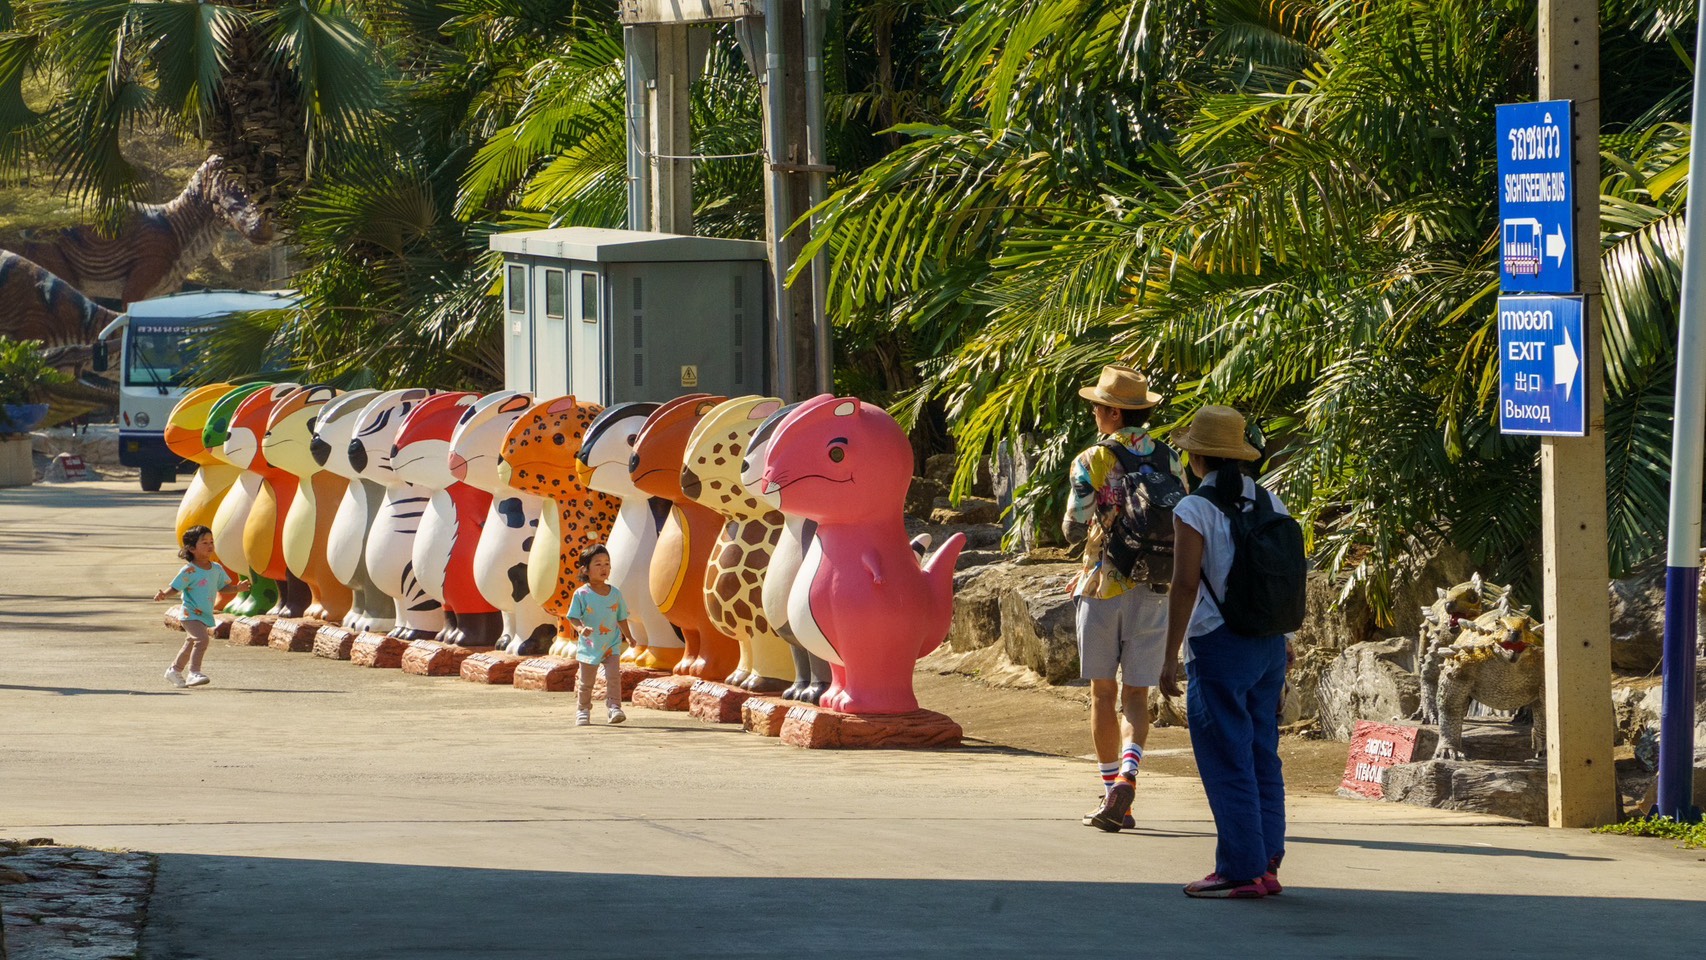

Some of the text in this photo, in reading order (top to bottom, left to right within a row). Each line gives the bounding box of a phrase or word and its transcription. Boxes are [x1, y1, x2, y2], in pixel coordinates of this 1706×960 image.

[1508, 112, 1560, 161] รถชมวิว
[1505, 171, 1566, 203] SIGHTSEEING BUS
[1501, 310, 1553, 331] ทางออก
[1508, 341, 1546, 361] EXIT
[1515, 371, 1541, 392] 出口
[1505, 399, 1551, 424] Выход
